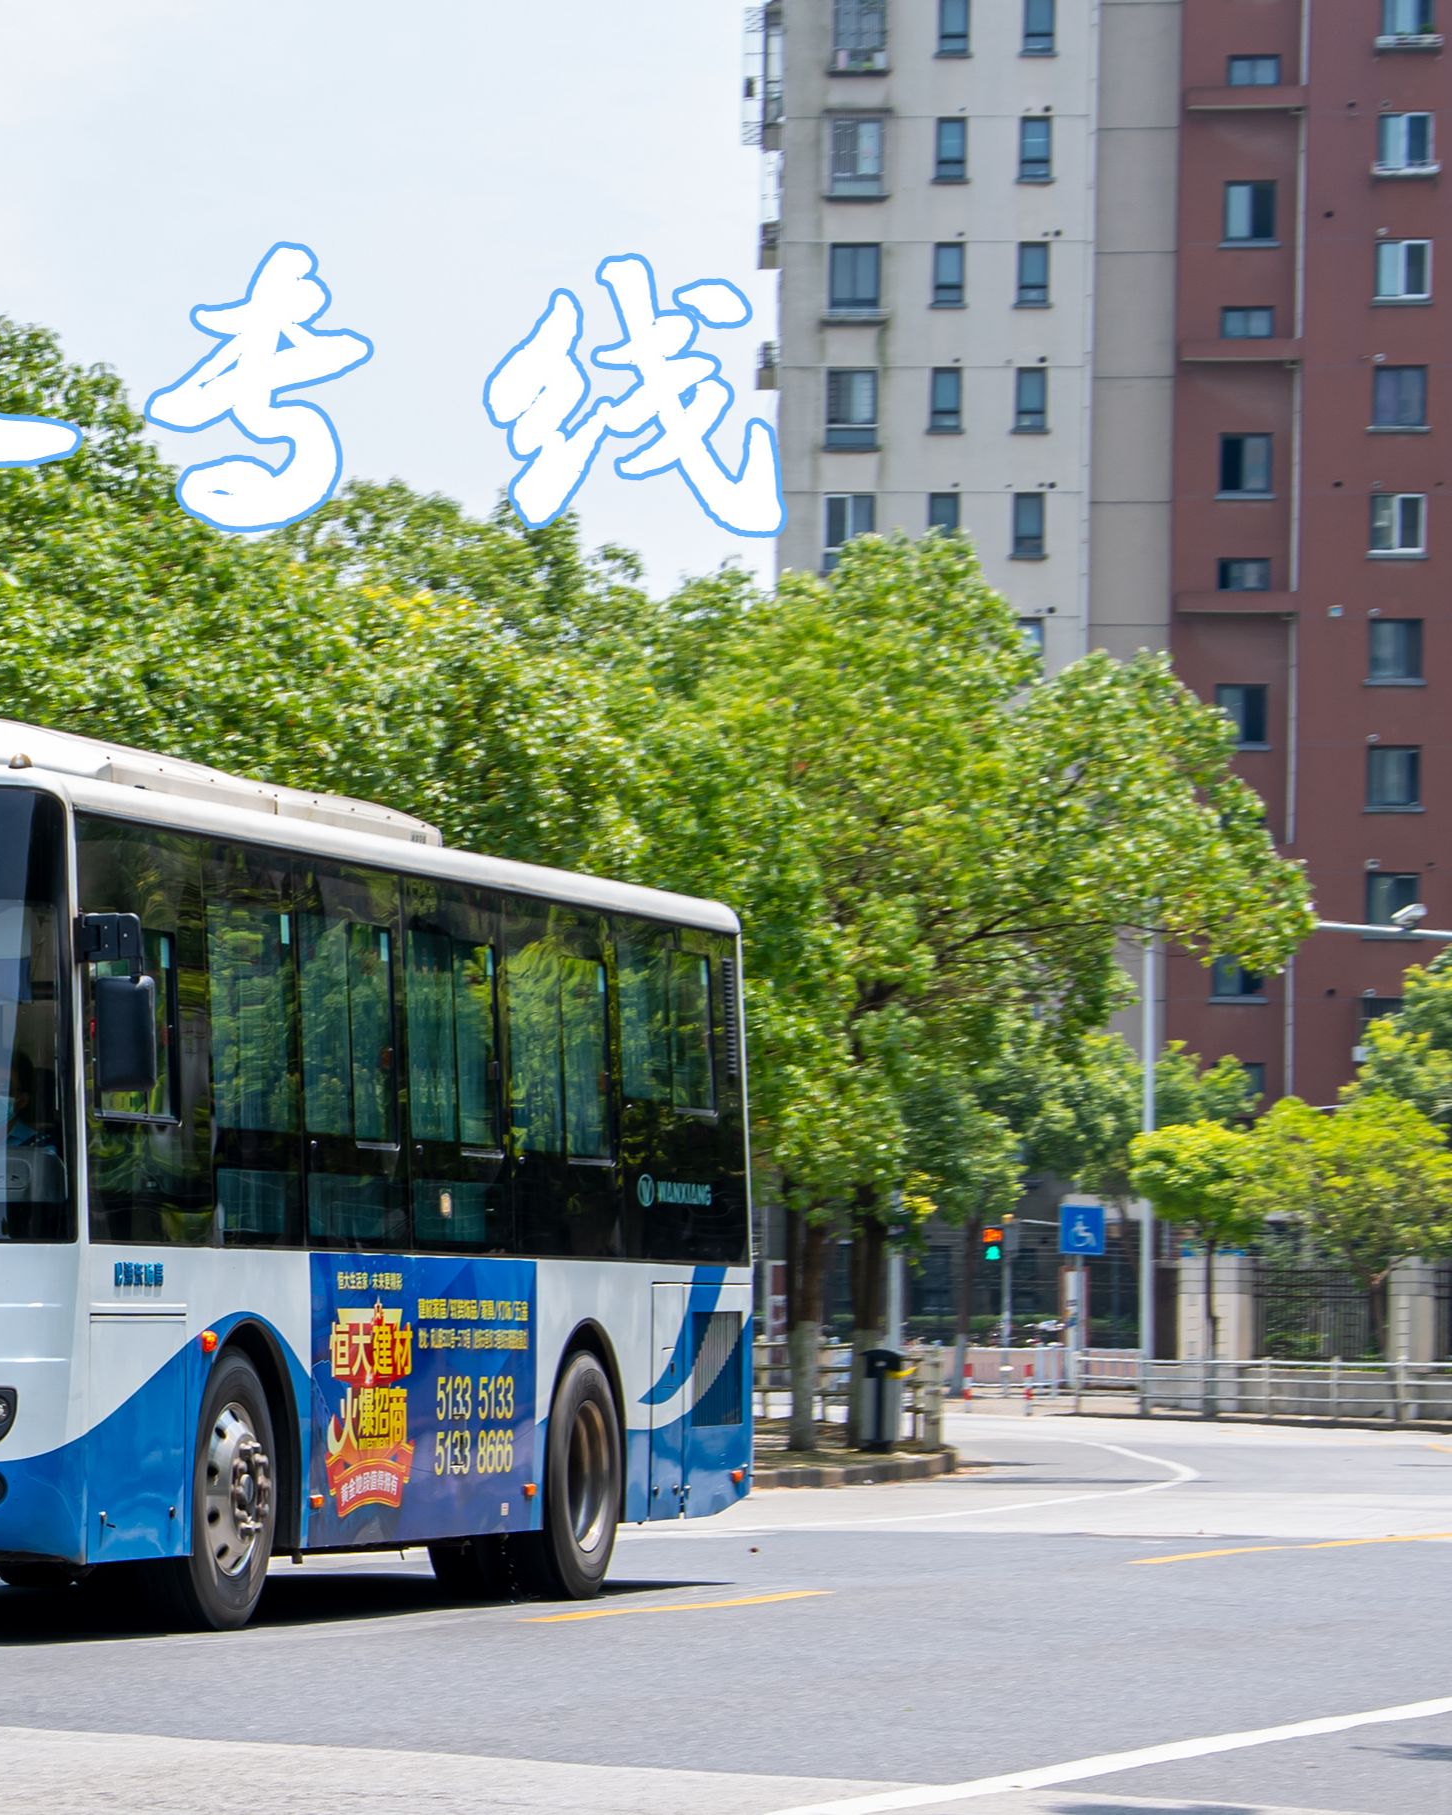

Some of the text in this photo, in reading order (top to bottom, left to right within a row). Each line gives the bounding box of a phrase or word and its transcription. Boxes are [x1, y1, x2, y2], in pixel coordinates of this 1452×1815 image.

[329, 1321, 413, 1377] 恒大建材
[327, 1386, 408, 1455] 火爆招商
[436, 1376, 514, 1421] 5133 5133
[435, 1430, 514, 1476] 5133 8666
